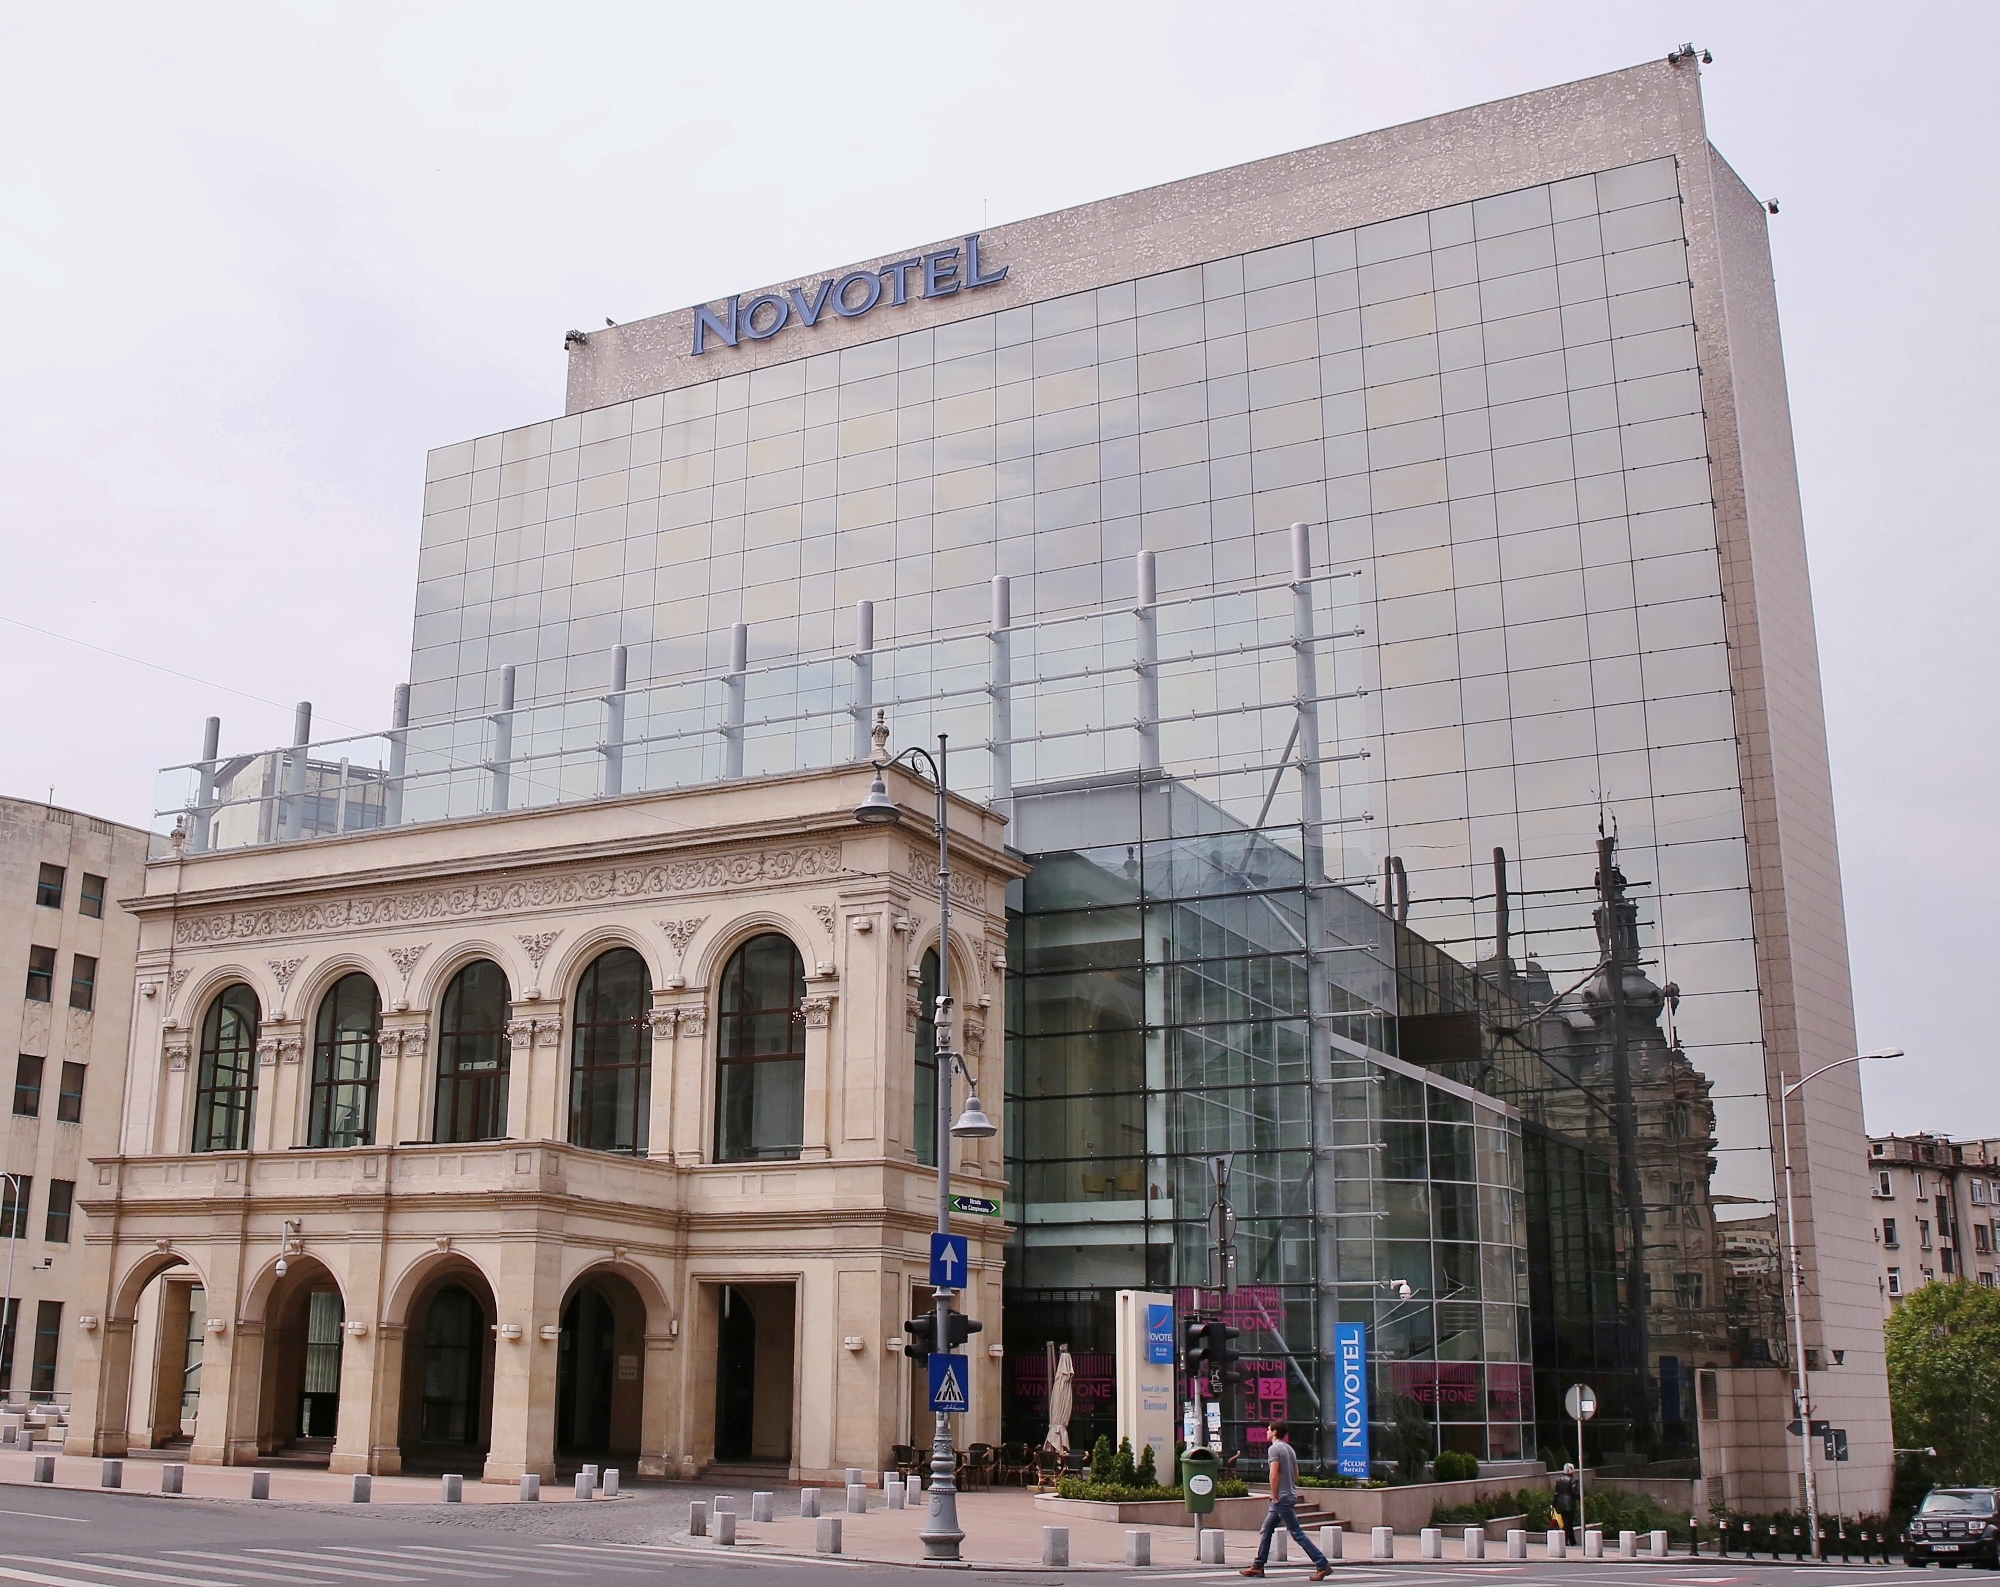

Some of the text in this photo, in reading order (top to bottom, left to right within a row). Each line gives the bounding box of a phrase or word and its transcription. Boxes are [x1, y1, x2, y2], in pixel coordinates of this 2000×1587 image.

[691, 233, 1009, 356] NOVOTEL
[1244, 1360, 1287, 1372] VINURI
[1262, 1380, 1283, 1397] 32
[1340, 1329, 1362, 1448] NOVOTEL
[1340, 1458, 1366, 1468] ACCOR
[1343, 1465, 1365, 1473] hotels
